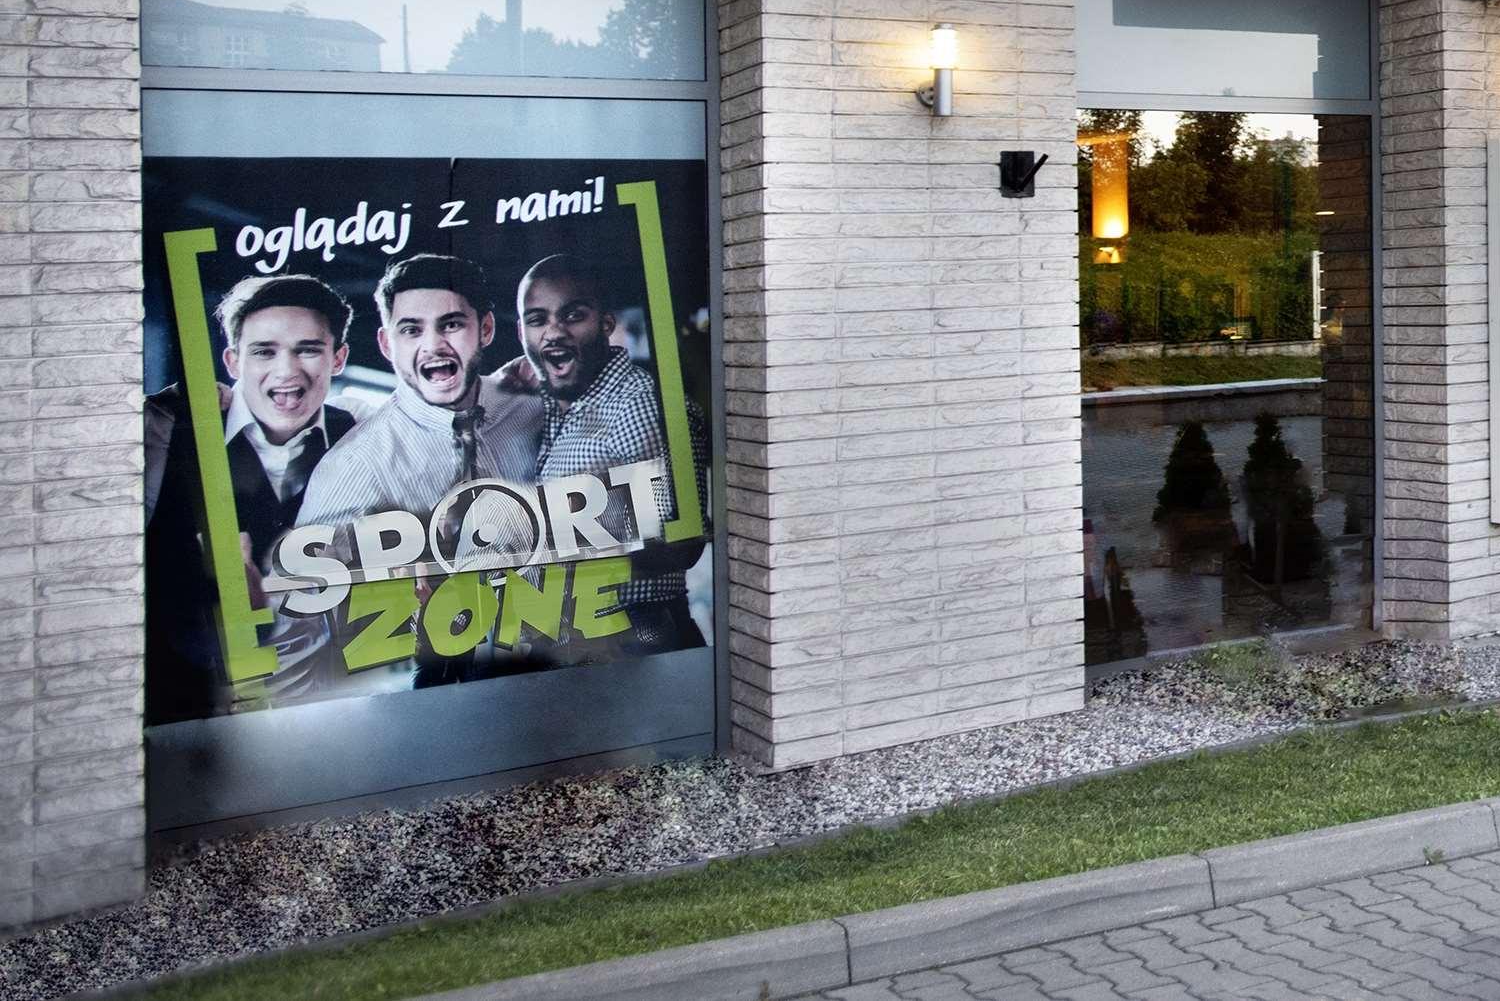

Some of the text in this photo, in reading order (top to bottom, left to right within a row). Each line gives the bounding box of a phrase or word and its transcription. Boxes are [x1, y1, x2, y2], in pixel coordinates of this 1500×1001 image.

[236, 176, 604, 273] oglądaj z nami!
[270, 456, 666, 616] SPORT
[344, 556, 633, 674] ZONE
